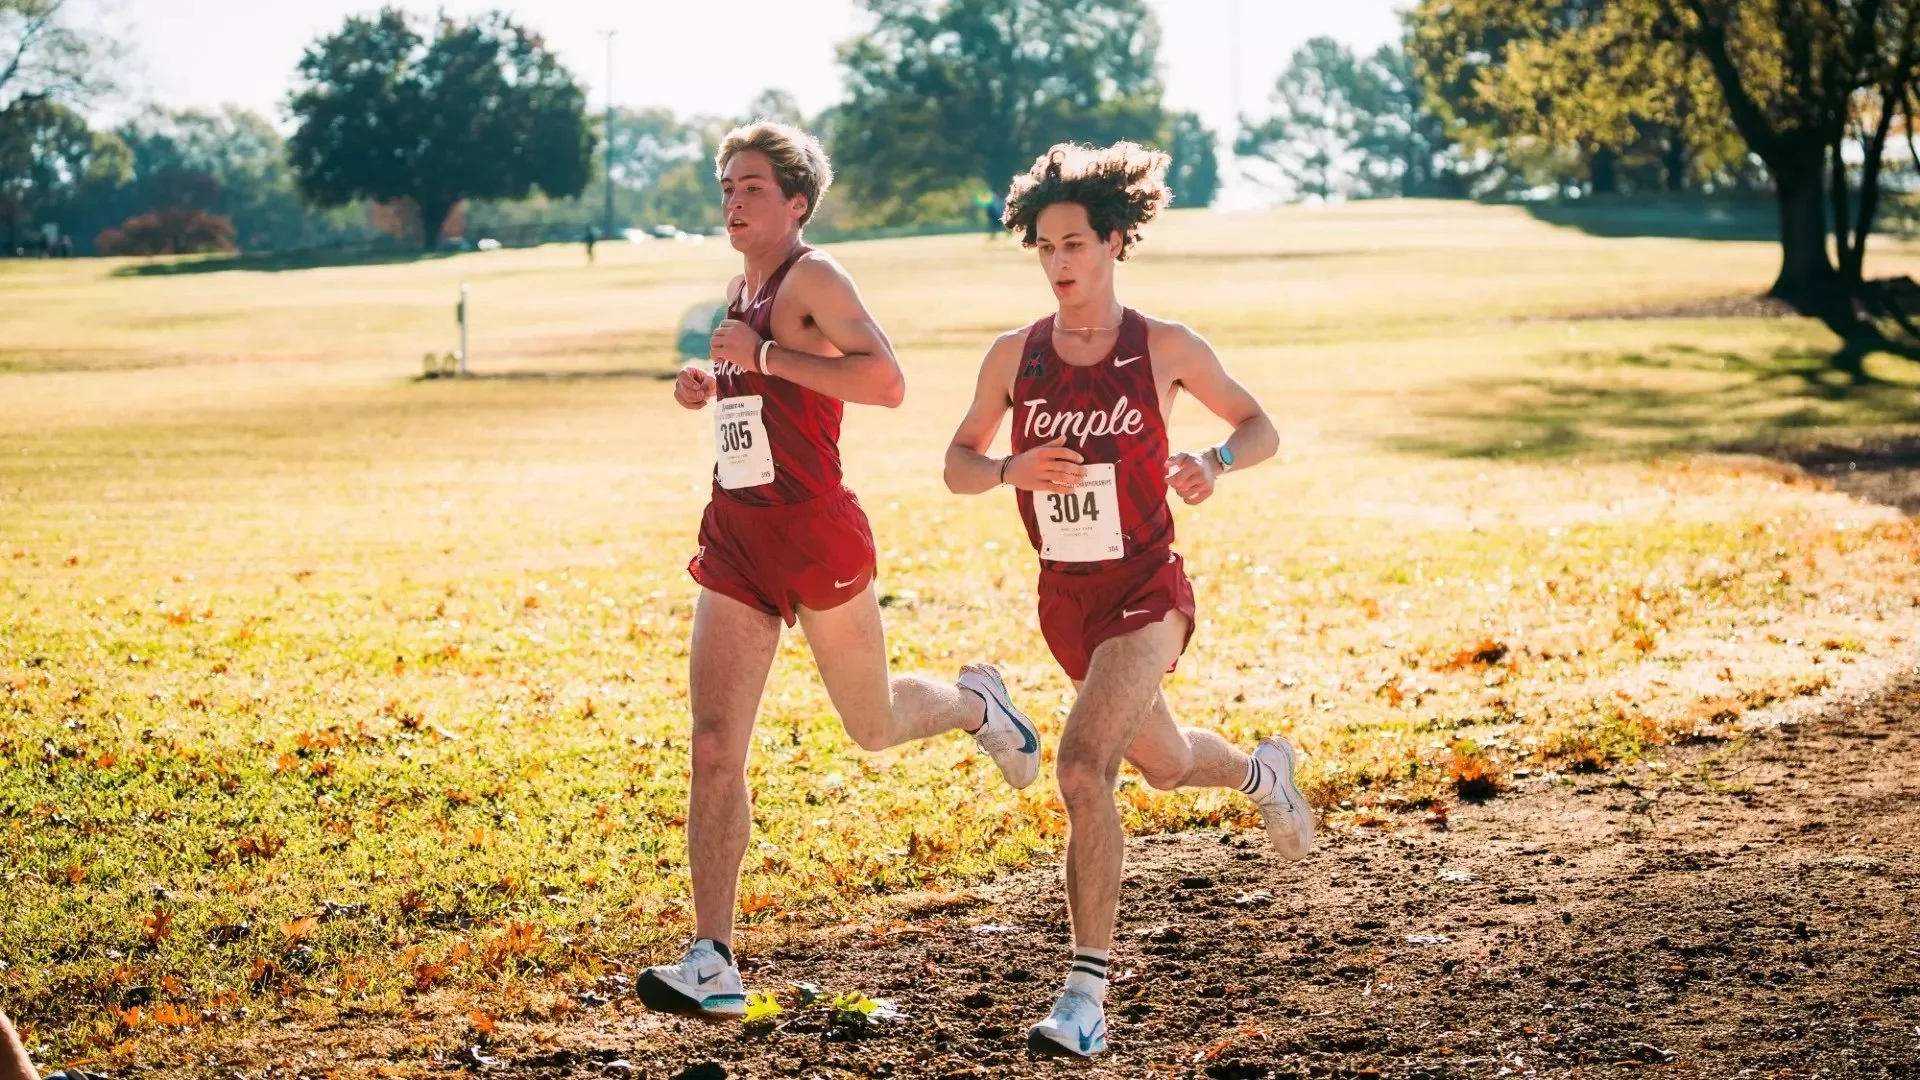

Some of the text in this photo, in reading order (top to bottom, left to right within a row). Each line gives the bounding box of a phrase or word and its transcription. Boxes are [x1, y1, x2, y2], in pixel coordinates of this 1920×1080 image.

[720, 420, 753, 453] 305
[1024, 395, 1144, 449] Temple
[1047, 491, 1100, 523] 304
